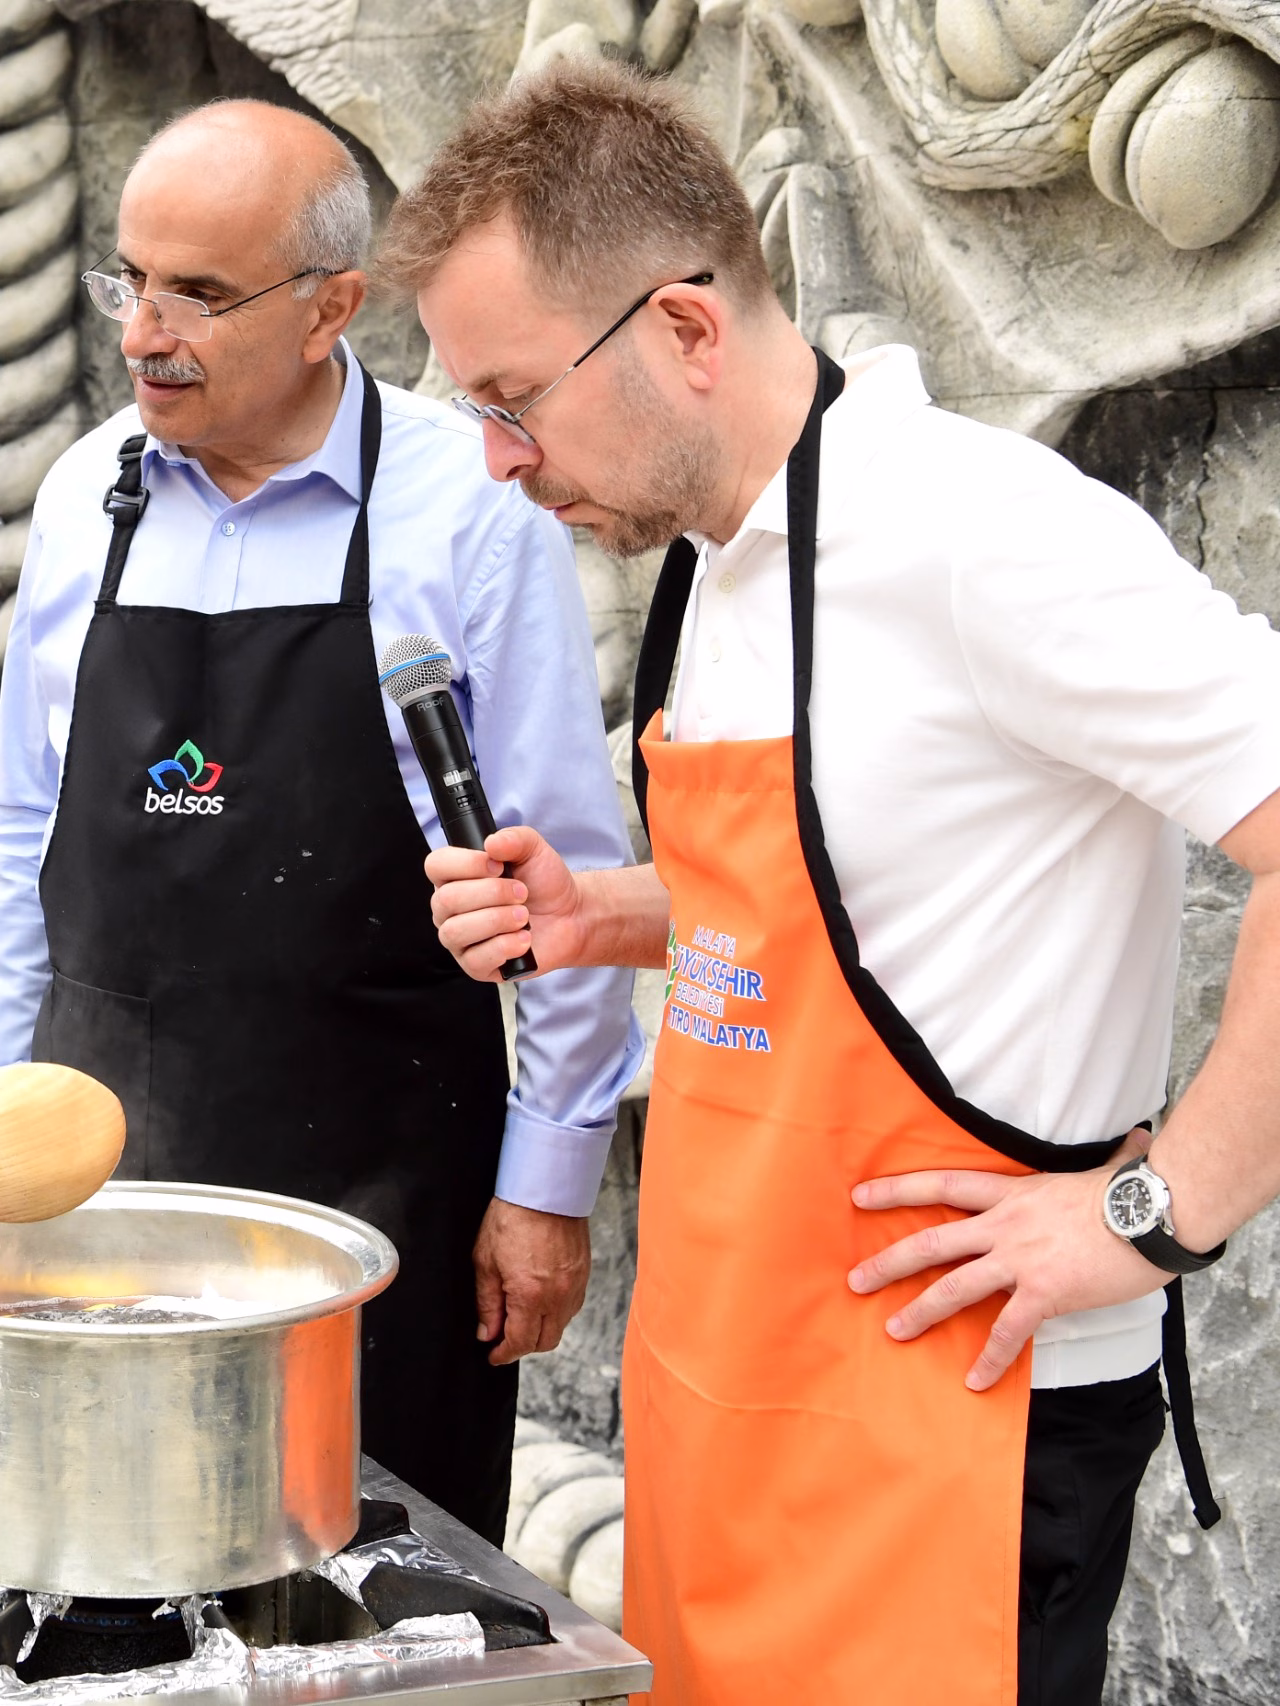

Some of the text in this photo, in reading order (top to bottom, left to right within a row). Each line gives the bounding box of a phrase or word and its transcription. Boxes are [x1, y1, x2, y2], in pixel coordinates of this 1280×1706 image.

[416, 697, 444, 712] Roof
[144, 787, 225, 815] belsos
[692, 925, 737, 959] MALATYA
[676, 944, 767, 1002] ÜYÜKŞEHİR
[666, 1005, 771, 1052] TRO MALATYA
